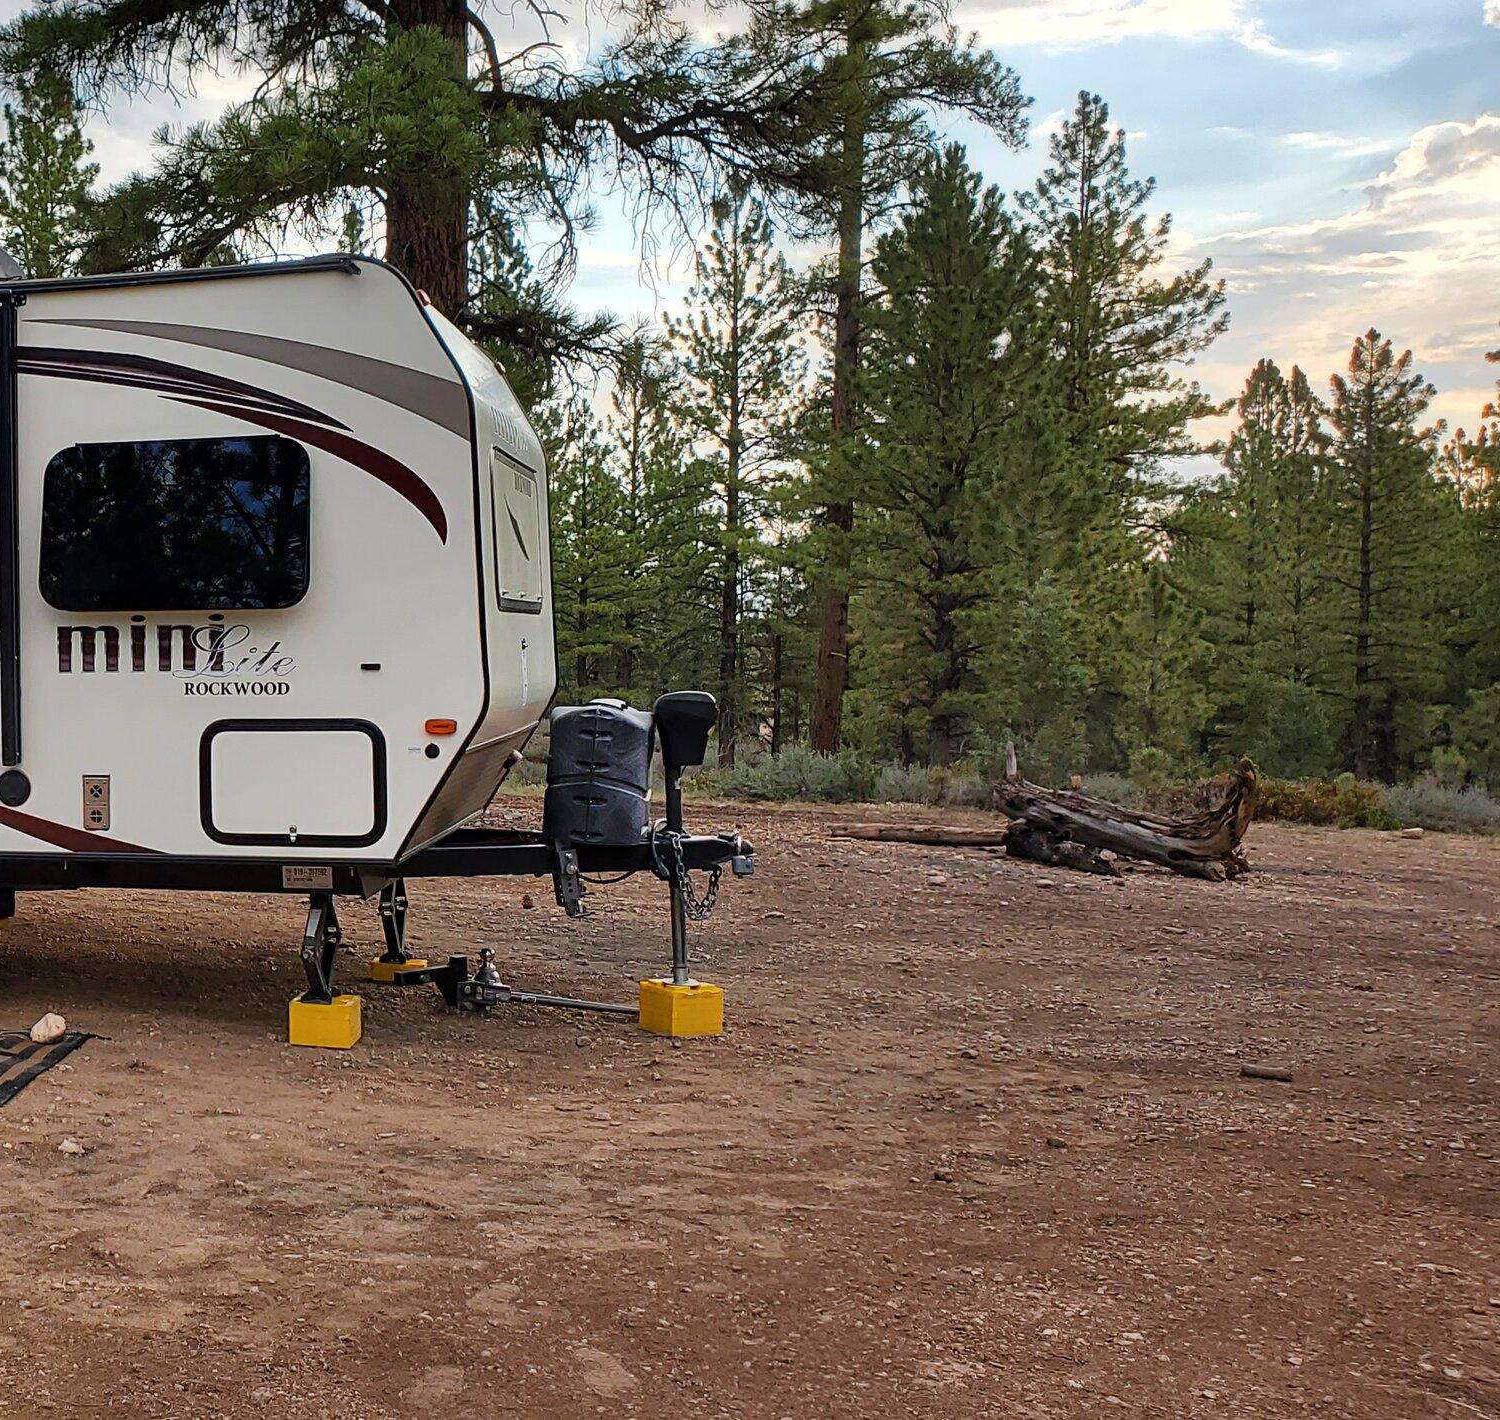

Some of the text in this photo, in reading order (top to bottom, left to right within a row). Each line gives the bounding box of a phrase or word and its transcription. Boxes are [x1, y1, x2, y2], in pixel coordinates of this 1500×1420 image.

[56, 614, 297, 679] mini Lite
[184, 682, 290, 696] ROCKWOOD
